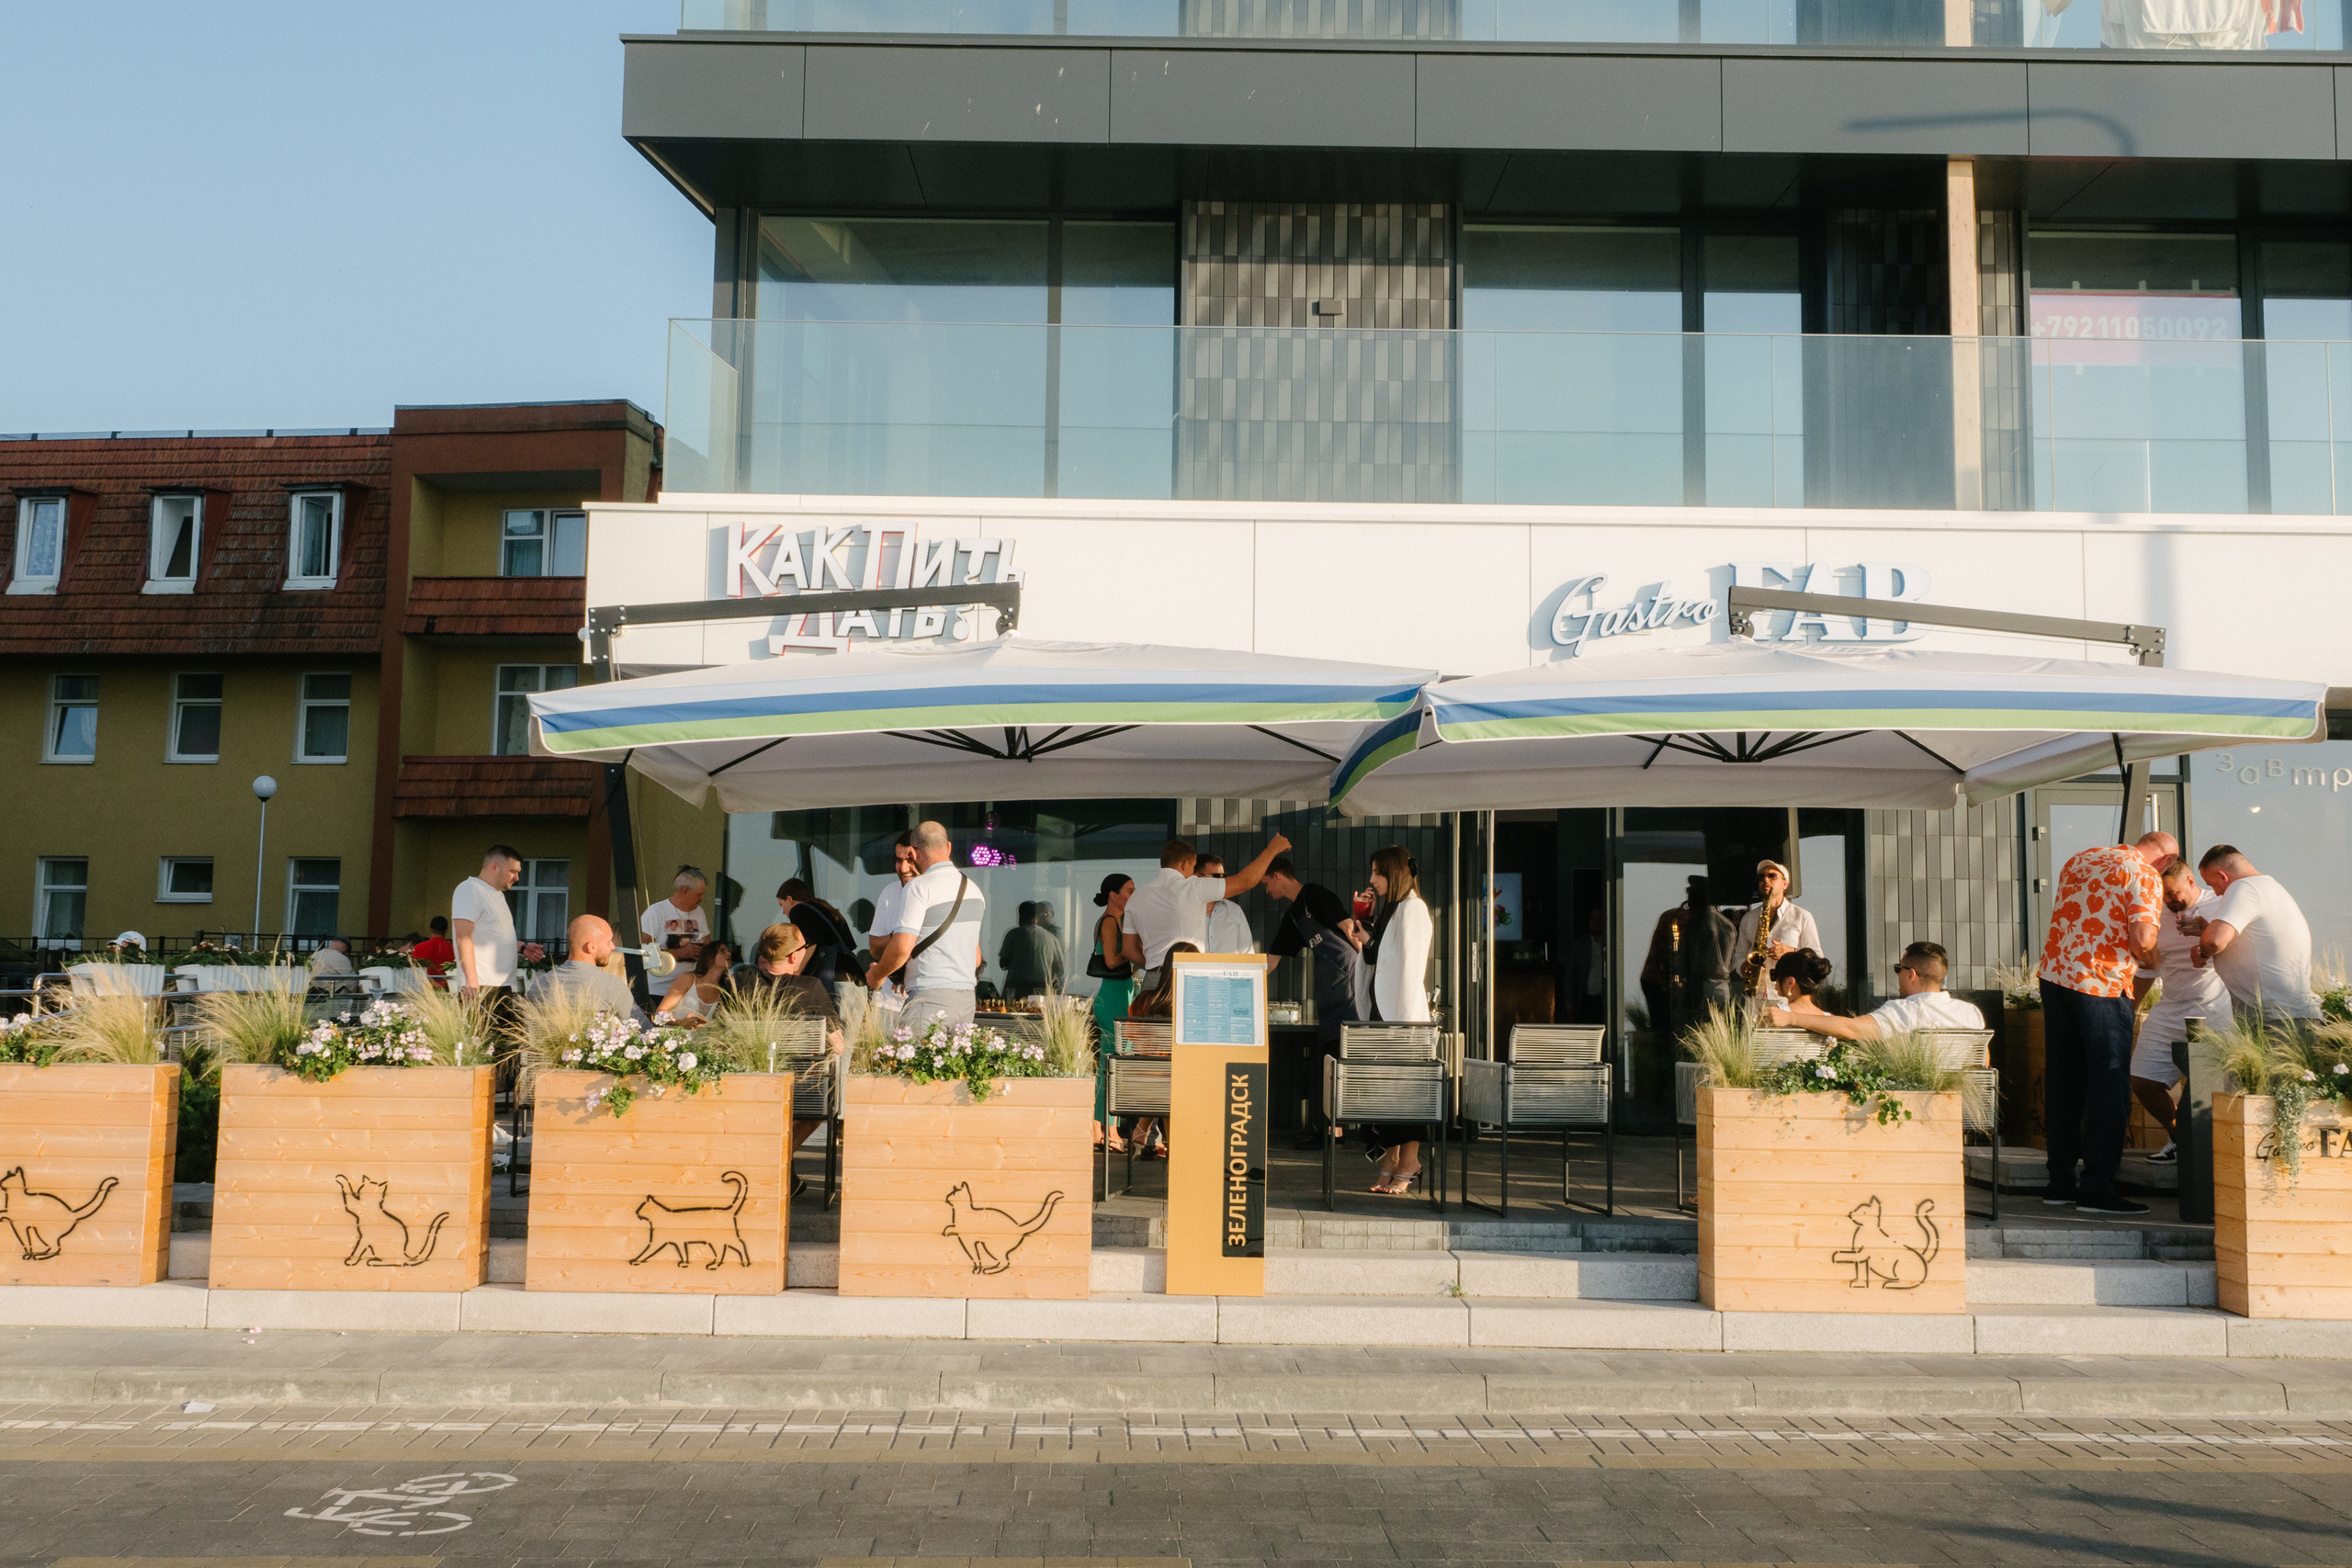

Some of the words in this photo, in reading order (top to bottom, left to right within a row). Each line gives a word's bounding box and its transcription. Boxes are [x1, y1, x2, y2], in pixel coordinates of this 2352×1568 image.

[2030, 315, 2228, 340] +79211050092
[727, 521, 854, 597] КАК
[1551, 572, 1721, 659] Gastro
[1728, 561, 1931, 642] FAB
[1227, 1074, 1252, 1247] ЗЕЛЕНОГРАДСК
